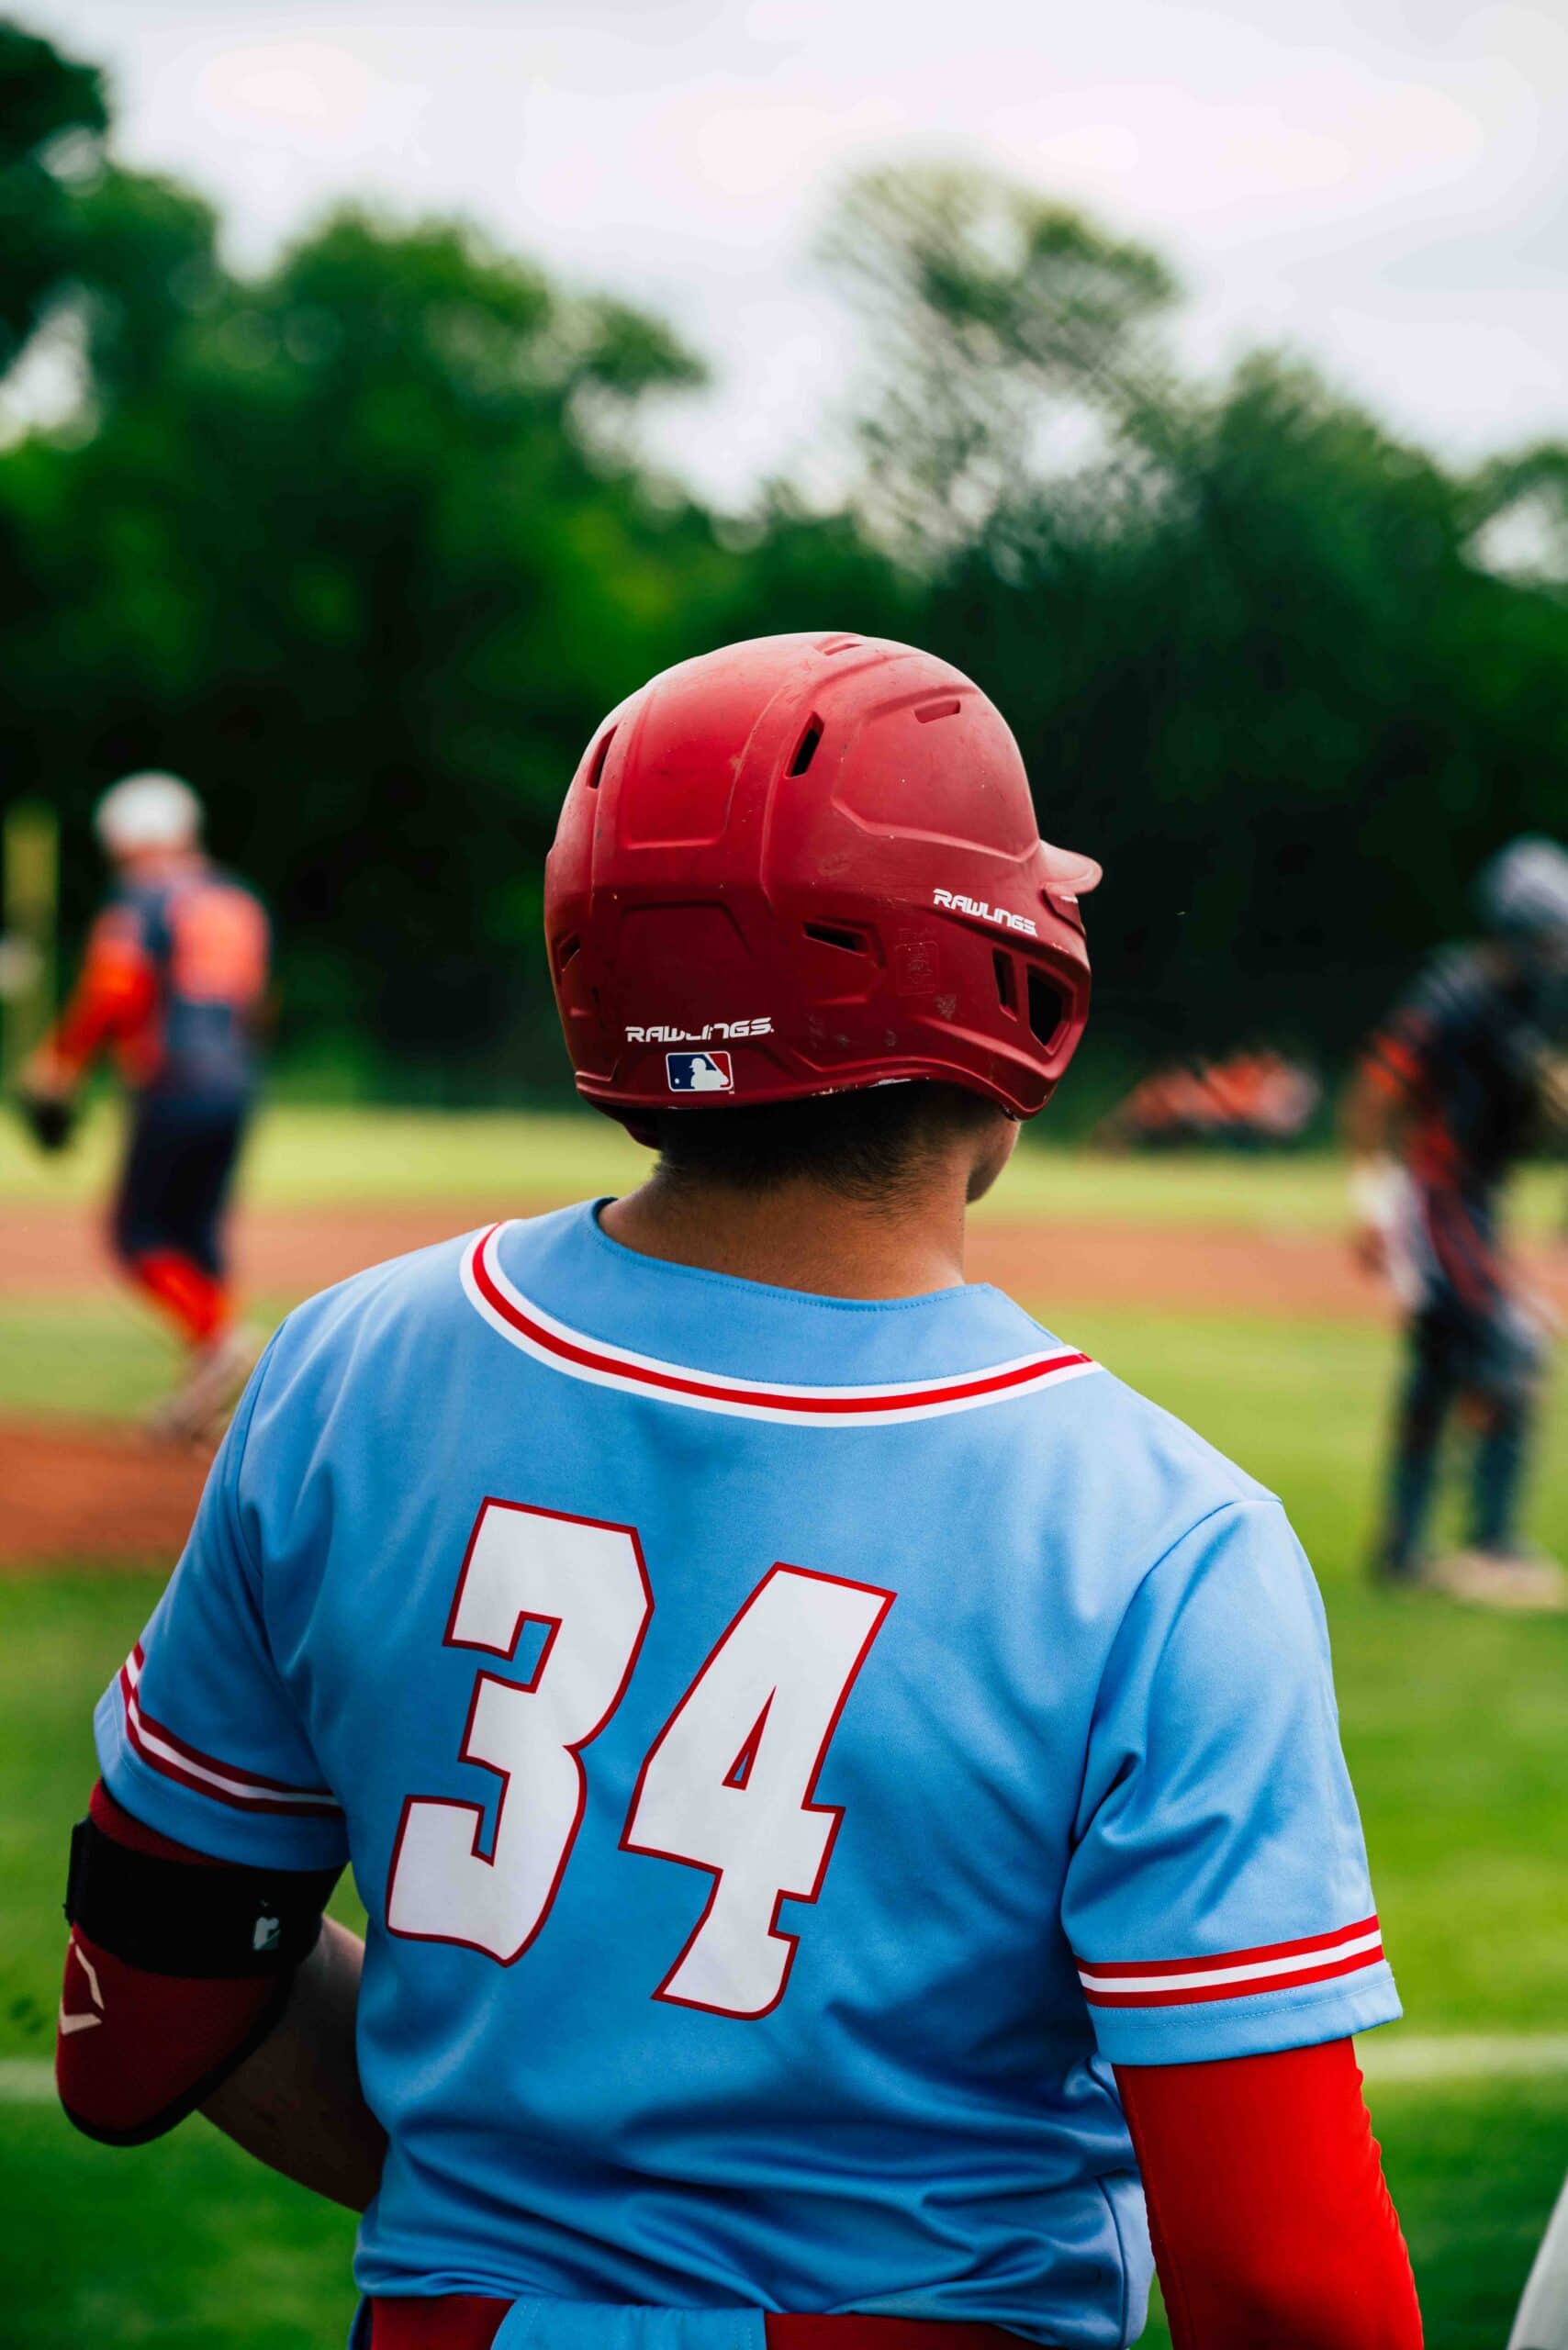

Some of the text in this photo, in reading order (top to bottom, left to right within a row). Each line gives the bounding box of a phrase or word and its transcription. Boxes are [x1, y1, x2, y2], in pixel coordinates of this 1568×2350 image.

[933, 888, 1037, 936] RAWLINGS
[625, 1017, 773, 1043] RAWLINGS
[386, 1496, 898, 2020] 34
